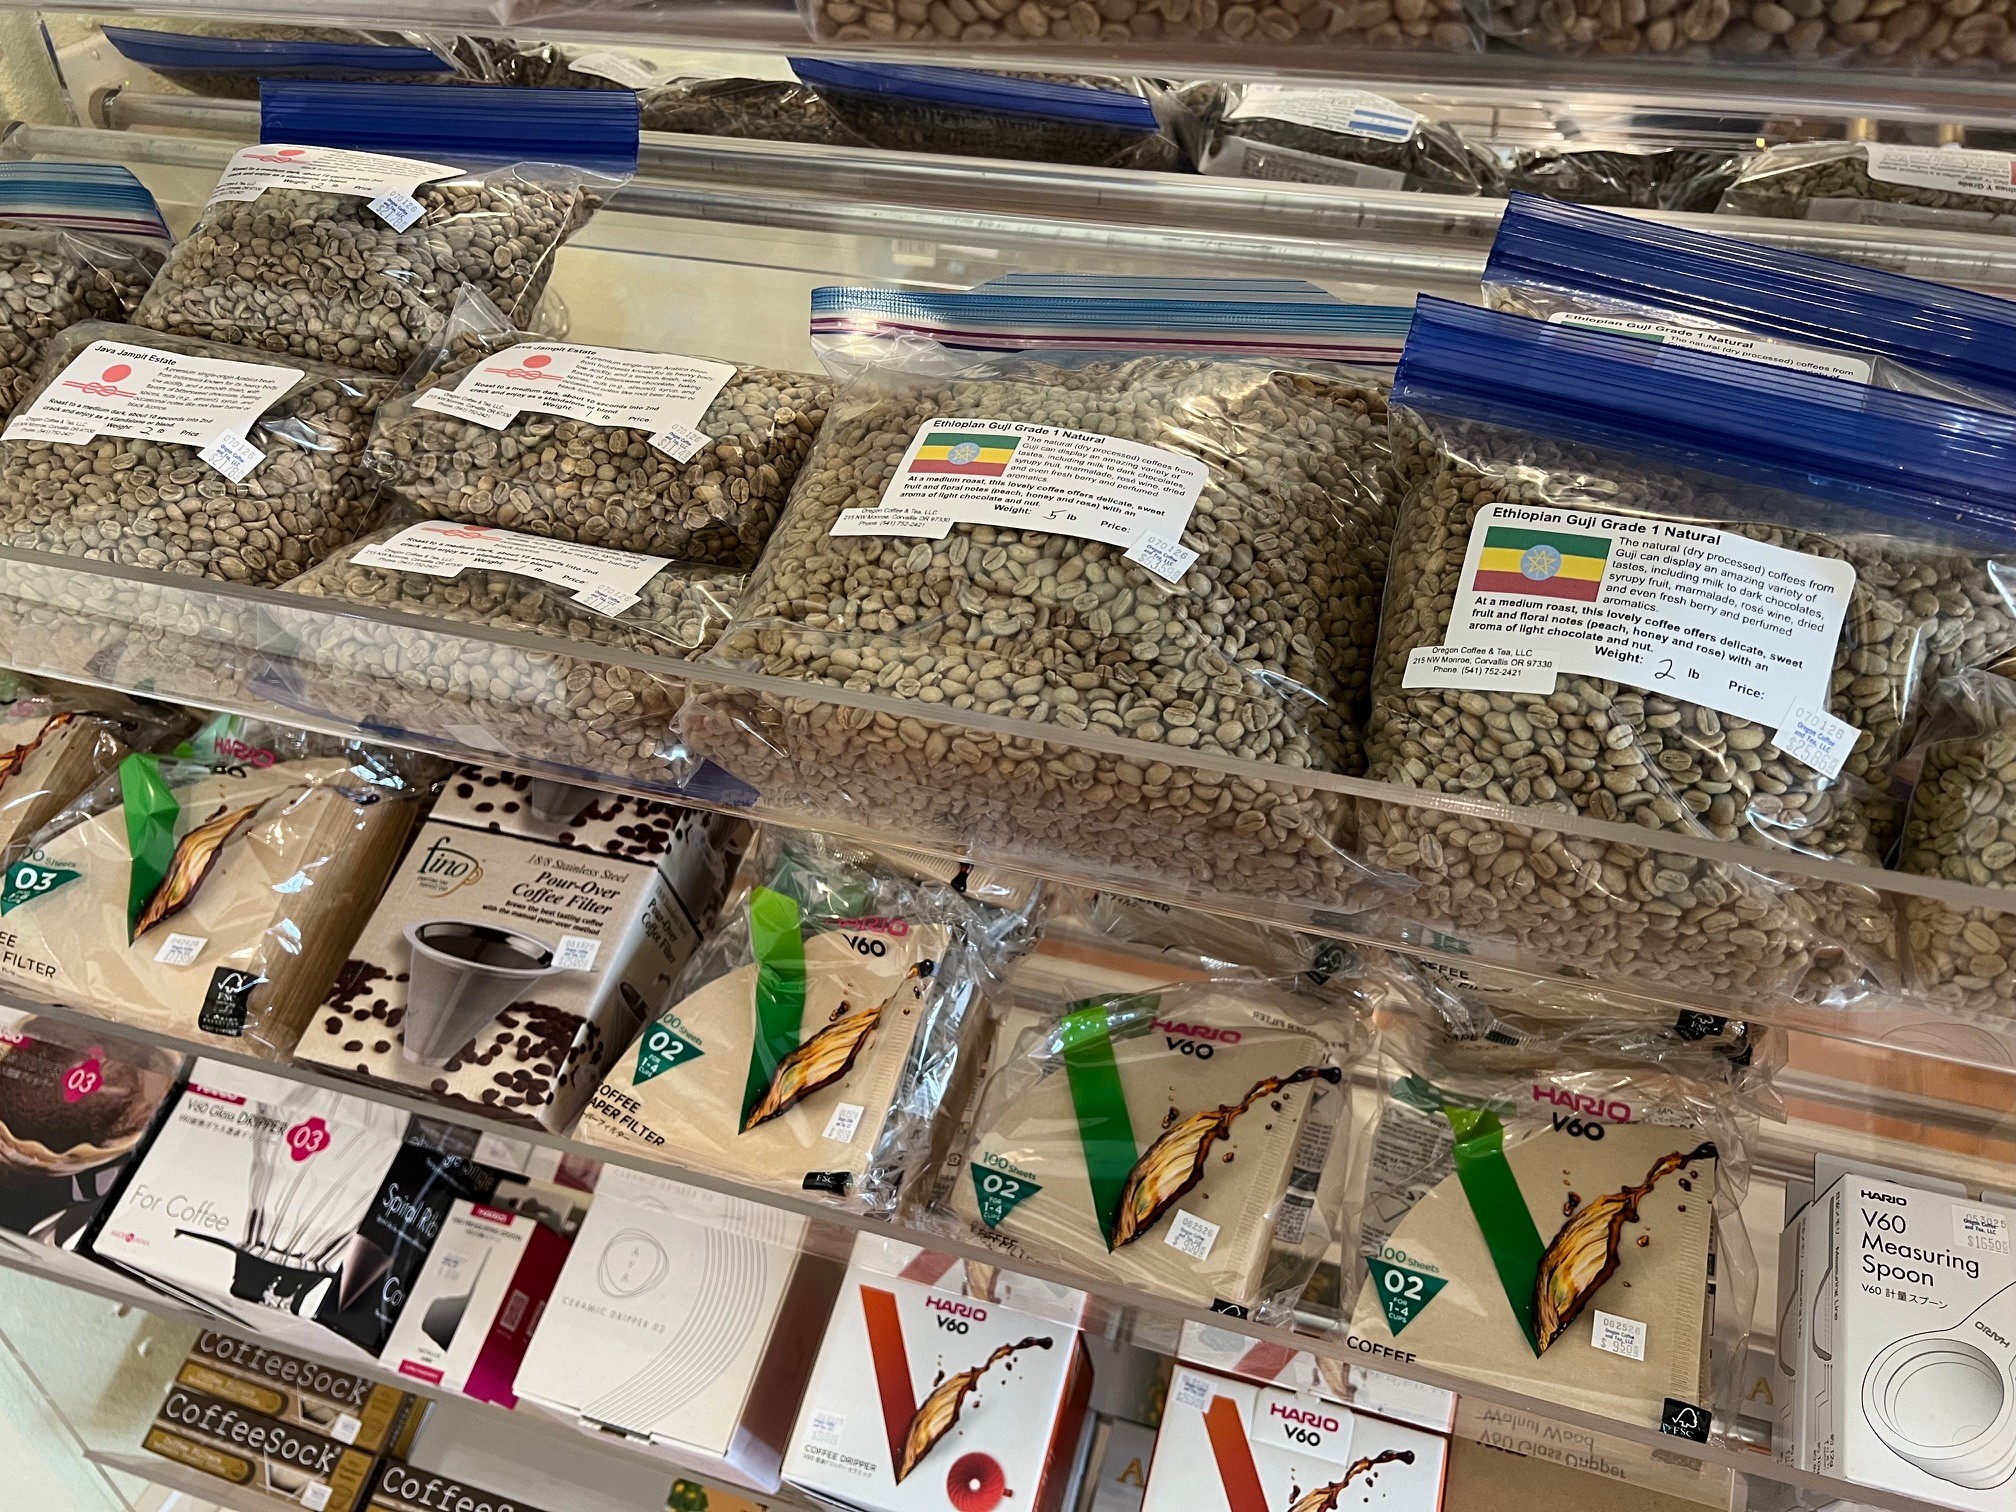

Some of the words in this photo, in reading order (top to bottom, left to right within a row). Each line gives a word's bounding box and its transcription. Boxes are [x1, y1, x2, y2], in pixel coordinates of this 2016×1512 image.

[1566, 314, 1623, 326] Ethiopian
[1627, 321, 1652, 332] Guji
[1656, 325, 1692, 337] Grade
[1707, 334, 1754, 349] Natural
[94, 345, 116, 354] Java
[116, 349, 148, 359] Jampit
[148, 354, 176, 365] Estate
[567, 347, 597, 355] Estate
[933, 419, 985, 428] Ethiopian
[988, 422, 1011, 431] Guji
[1014, 425, 1049, 434] Grade
[1061, 430, 1105, 443] Natural
[223, 434, 256, 460] 070126
[994, 504, 1031, 515] Weight:
[1100, 520, 1131, 534] Price:
[1492, 506, 1561, 523] Ethiopian
[1566, 514, 1596, 529] Guji
[1601, 518, 1646, 533] Grade
[1651, 524, 1658, 534] 1
[1664, 526, 1720, 545] Natural
[1148, 536, 1189, 560] 070126
[1615, 548, 1637, 560] Guji
[1639, 553, 1659, 562] can
[1662, 554, 1701, 571] display
[1703, 565, 1717, 574] an
[1720, 569, 1764, 588] amazing
[1768, 583, 1802, 599] variety
[1805, 594, 1817, 602] of
[1618, 536, 1639, 547] The
[1641, 541, 1680, 552] natural
[1682, 545, 1704, 559] (dry
[1706, 552, 1765, 576] processed)
[1767, 570, 1806, 586] coffees
[1808, 579, 1834, 593] from
[1602, 596, 1658, 612] aromatics.
[1608, 573, 1645, 585] syrupy
[1648, 576, 1670, 590] fruit,
[1674, 584, 1737, 607] marmalade,
[1740, 602, 1763, 614] rosé
[1767, 610, 1793, 624] wine,
[1797, 617, 1824, 632] dried
[1612, 560, 1646, 573] tastes,
[1650, 564, 1699, 584] including
[1702, 577, 1724, 588] milk
[1726, 582, 1736, 592] to
[1739, 587, 1762, 600] dark
[1765, 595, 1823, 620] chocolates,
[1605, 584, 1627, 593] and
[1629, 588, 1656, 598] even
[1659, 591, 1686, 605] fresh
[1689, 598, 1717, 615] berry
[1719, 609, 1740, 620] and
[1741, 616, 1792, 636] perfumed
[1468, 622, 1502, 630] aroma
[1505, 623, 1518, 631] of
[1519, 623, 1544, 635] light
[1547, 626, 1603, 641] chocolate
[1606, 636, 1629, 646] and
[1631, 640, 1653, 652] nut.
[1471, 608, 1494, 617] fruit
[1496, 610, 1517, 619] and
[1519, 611, 1549, 622] floral
[1551, 616, 1583, 626] notes
[1586, 618, 1628, 634] (peach,
[1632, 626, 1669, 643] honey
[1671, 638, 1693, 649] and
[1695, 644, 1725, 660] rose)
[1728, 653, 1751, 666] with
[1754, 662, 1768, 671] an
[1474, 596, 1487, 605] At
[1498, 598, 1543, 609] medium
[1545, 603, 1577, 614] roast,
[1581, 606, 1603, 616] this
[1606, 609, 1642, 624] lovely
[1644, 618, 1680, 631] coffee
[1683, 627, 1716, 642] offers
[1719, 636, 1765, 658] delicate,
[1769, 653, 1802, 668] sweet
[1431, 646, 1458, 655] Oregon
[1497, 648, 1512, 656] Tea,
[1595, 645, 1643, 663] Weight:
[1688, 668, 1700, 680] lb
[1728, 680, 1765, 700] Price:
[1654, 659, 1676, 679] 2
[1796, 708, 1844, 740] 070126
[1797, 722, 1816, 736] Oregon
[1818, 734, 1835, 747] Coffee
[418, 836, 469, 878] fino
[15, 867, 57, 890] 03
[535, 871, 620, 899] Pour-Over
[553, 860, 599, 876] Stainless
[600, 869, 629, 883] Steel
[512, 883, 564, 904] Coffee
[565, 894, 612, 915] Filter
[842, 934, 886, 957] V60
[3, 951, 56, 979] FILTER
[680, 1025, 703, 1045] Sheets
[1148, 1016, 1241, 1044] HARIO
[649, 1032, 684, 1061] 02
[1166, 1036, 1214, 1059] V60
[68, 1069, 96, 1093] 03
[598, 1085, 641, 1114] OFFEE
[1532, 1084, 1631, 1122] HARIO
[590, 1097, 621, 1119] APER
[619, 1115, 665, 1146] FILTER
[1552, 1111, 1605, 1141] V60
[293, 1126, 324, 1151] 03
[983, 1152, 1008, 1169] 100
[1008, 1164, 1036, 1180] Sheets
[983, 1174, 1019, 1198] 02
[1861, 1190, 1907, 1206] HARIO
[129, 1184, 162, 1210] For
[166, 1194, 230, 1231] Coffee
[382, 1182, 422, 1224] Spiral
[984, 1202, 1002, 1214] 1-4
[1861, 1208, 1906, 1234] V60
[1378, 1245, 1406, 1263] 100
[1407, 1256, 1440, 1274] Sheets
[1861, 1231, 1979, 1279] Measuring
[1862, 1254, 1934, 1287] Spoon
[1384, 1269, 1424, 1301] 02
[1862, 1283, 1881, 1295] V60
[1885, 1288, 1948, 1309] 計量スプーン
[925, 1295, 987, 1322] HARIO
[1388, 1302, 1409, 1317] 1-4
[1393, 1297, 1408, 1306] FOR
[936, 1315, 969, 1335] V60
[1388, 1312, 1407, 1324] CUPS
[200, 1329, 368, 1406] CoffeeSock
[1270, 1402, 1339, 1433] HARIO
[165, 1393, 336, 1472] CoffeeSock
[1284, 1423, 1321, 1446] V60
